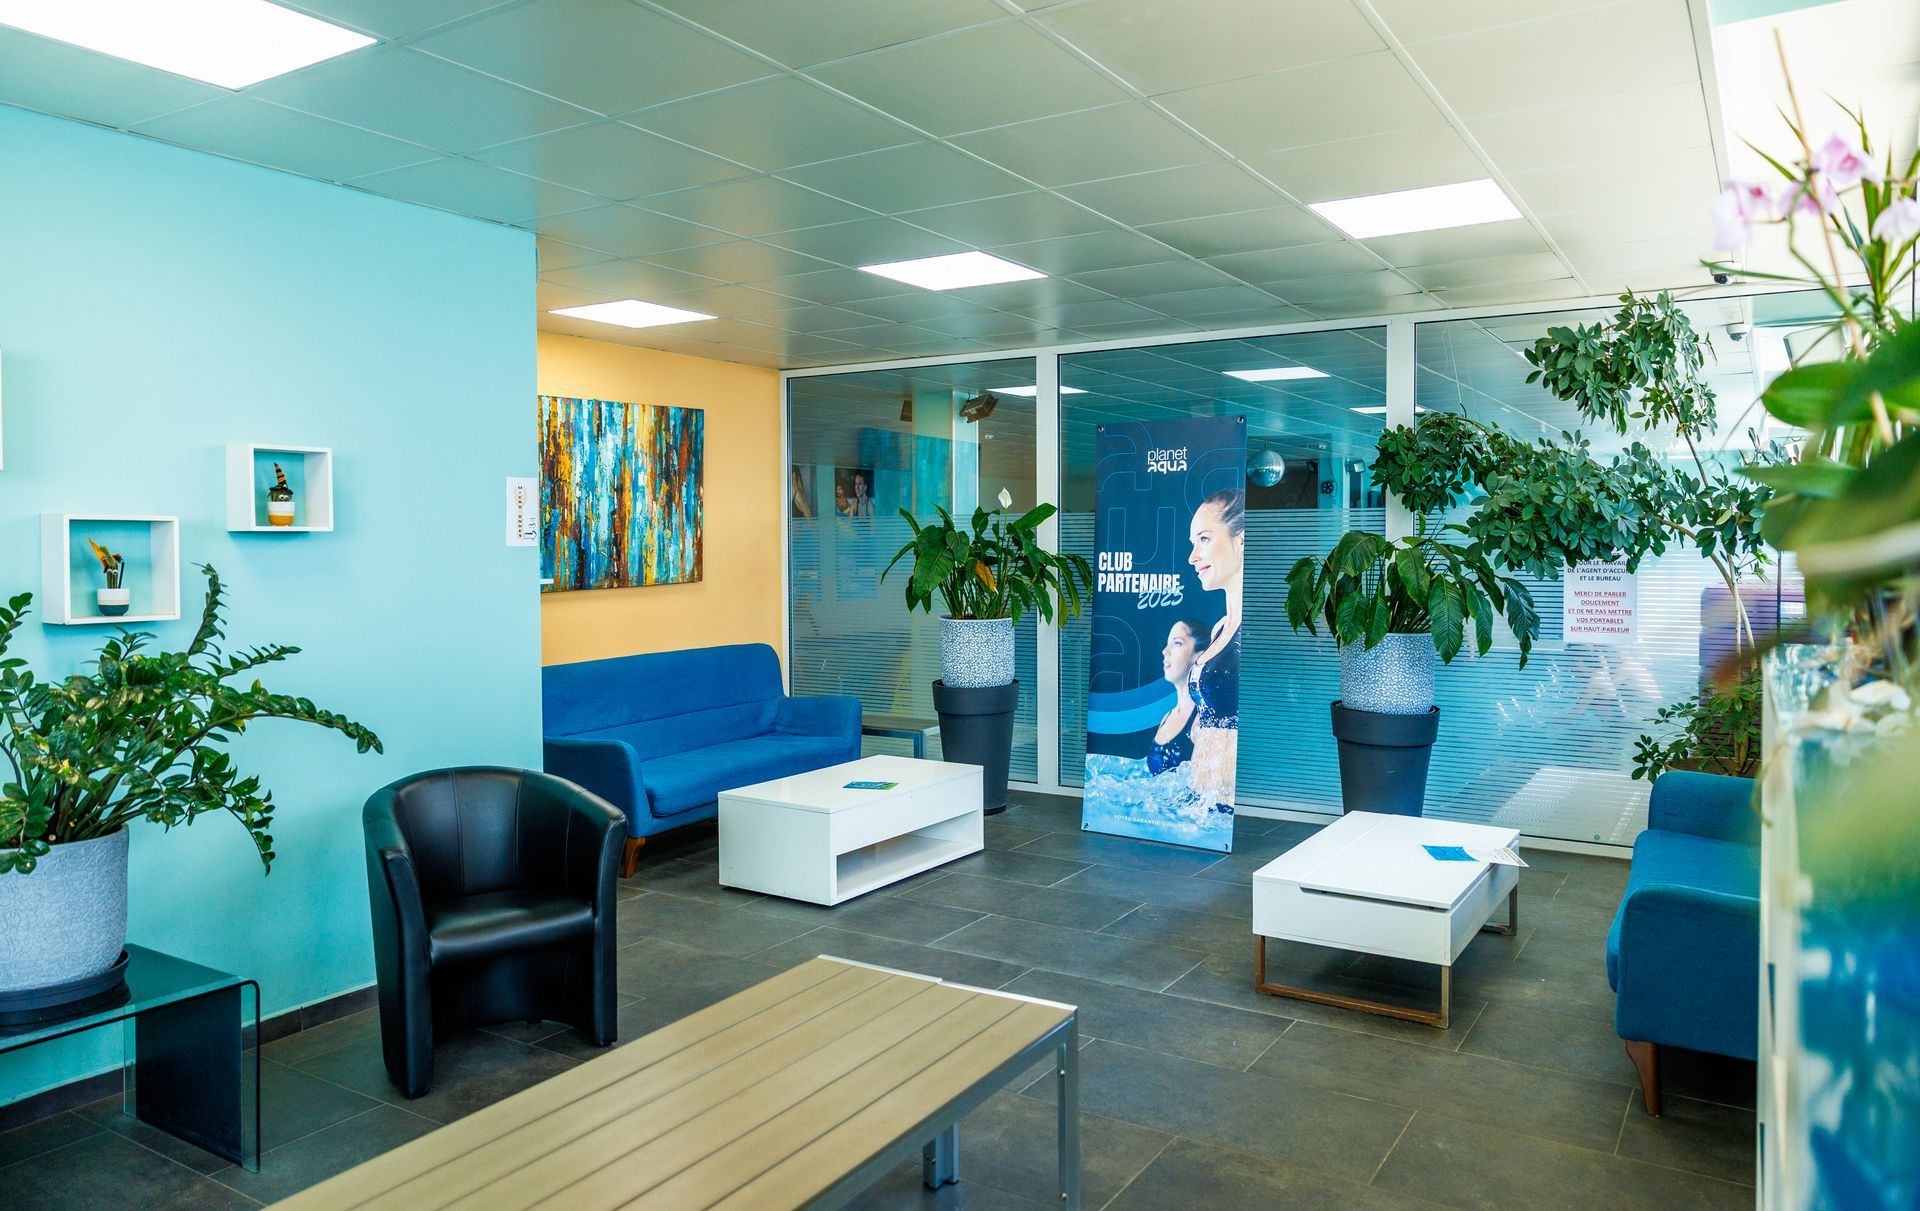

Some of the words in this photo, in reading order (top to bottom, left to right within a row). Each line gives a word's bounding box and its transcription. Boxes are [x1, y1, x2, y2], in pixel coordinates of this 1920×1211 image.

[1147, 446, 1187, 465] planet
[1147, 460, 1187, 474] aqua
[1098, 551, 1133, 572] CLUB
[1097, 572, 1181, 594] PARTENAIRE
[1137, 585, 1185, 610] 2025
